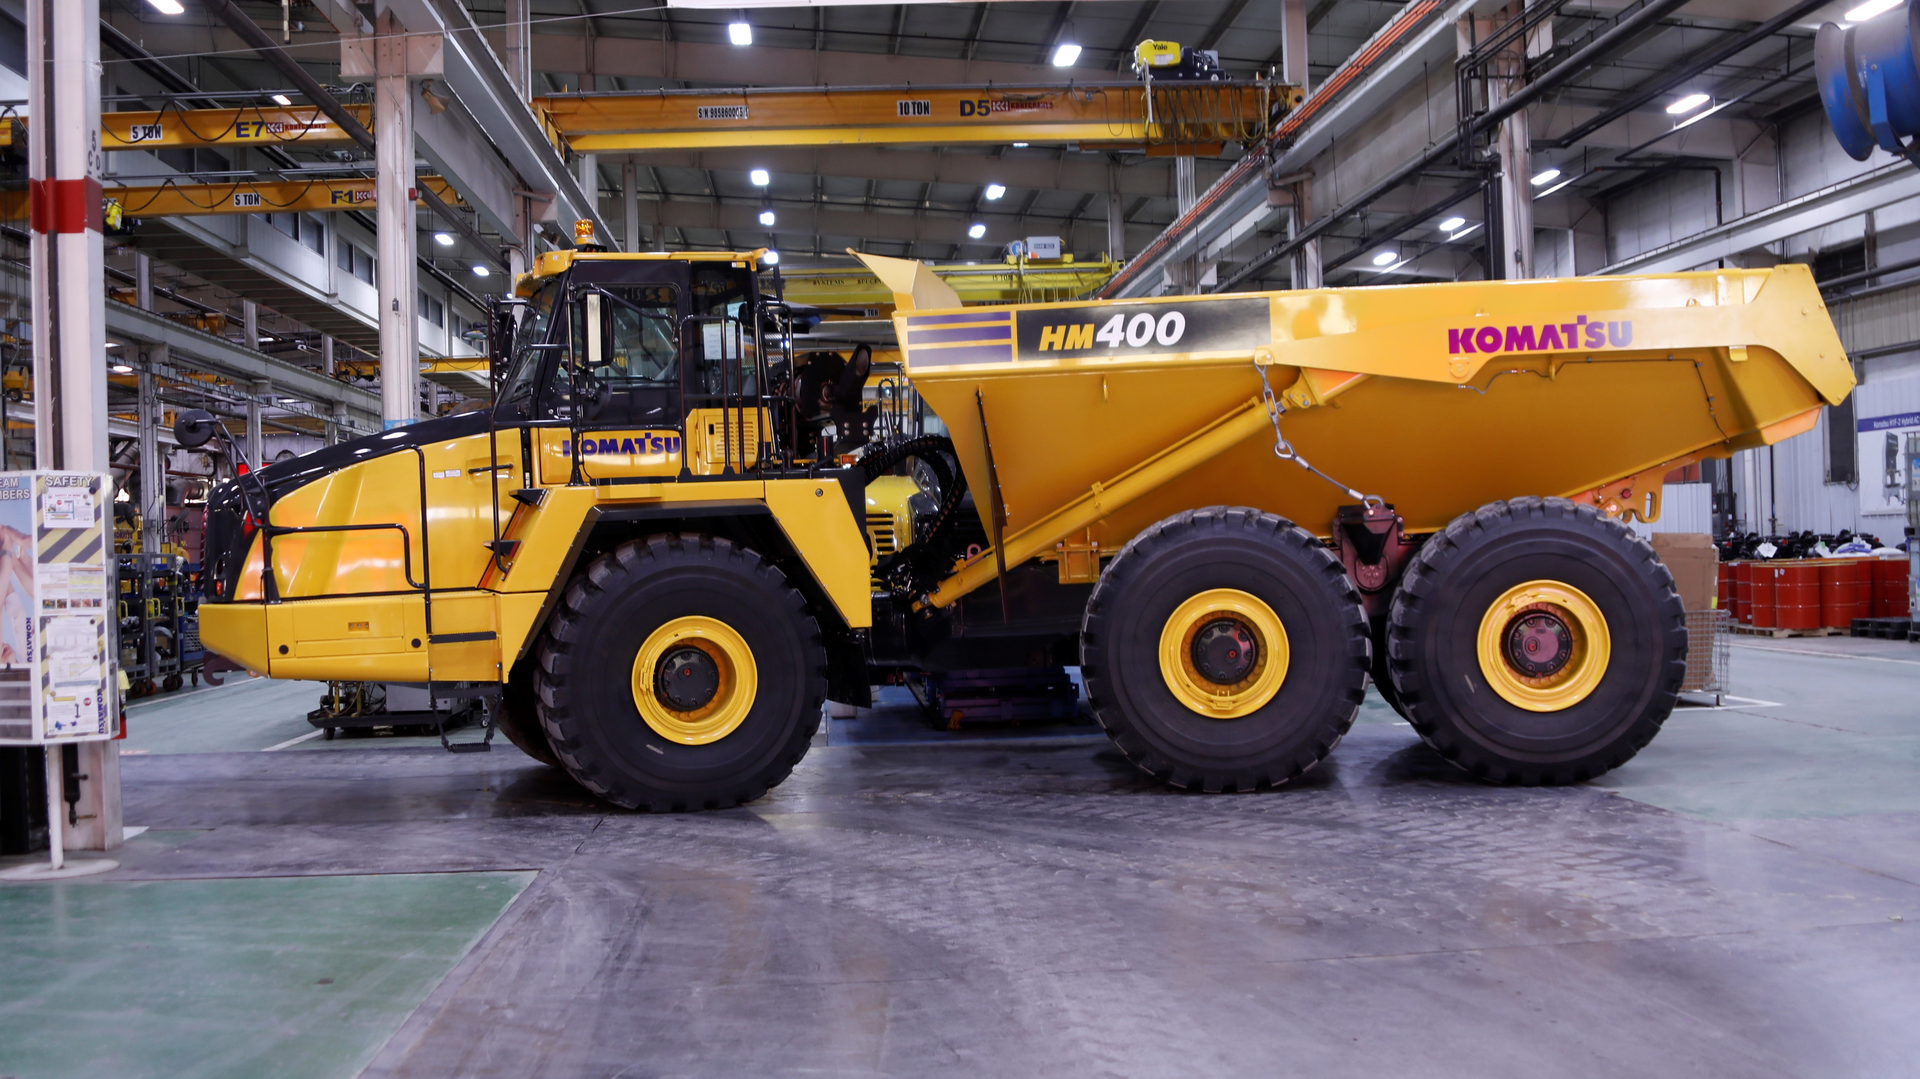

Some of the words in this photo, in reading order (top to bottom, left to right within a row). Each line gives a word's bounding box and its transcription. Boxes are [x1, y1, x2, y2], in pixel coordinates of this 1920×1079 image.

[698, 107, 709, 118] S/N
[900, 102, 910, 115] 10
[912, 101, 930, 115] TON
[960, 100, 991, 117] D5
[132, 126, 138, 139] 5
[142, 125, 161, 139] TON
[236, 120, 265, 138] E7
[234, 194, 241, 205] 5
[243, 194, 260, 205] TON
[331, 190, 354, 204] F1
[867, 309, 879, 317] TON
[1448, 315, 1633, 354] KOMATSU
[562, 432, 681, 457] KOMATSU
[45, 476, 93, 488] SAFETY
[26, 617, 34, 663] KOMATSU
[97, 692, 105, 734] KOMATSU
